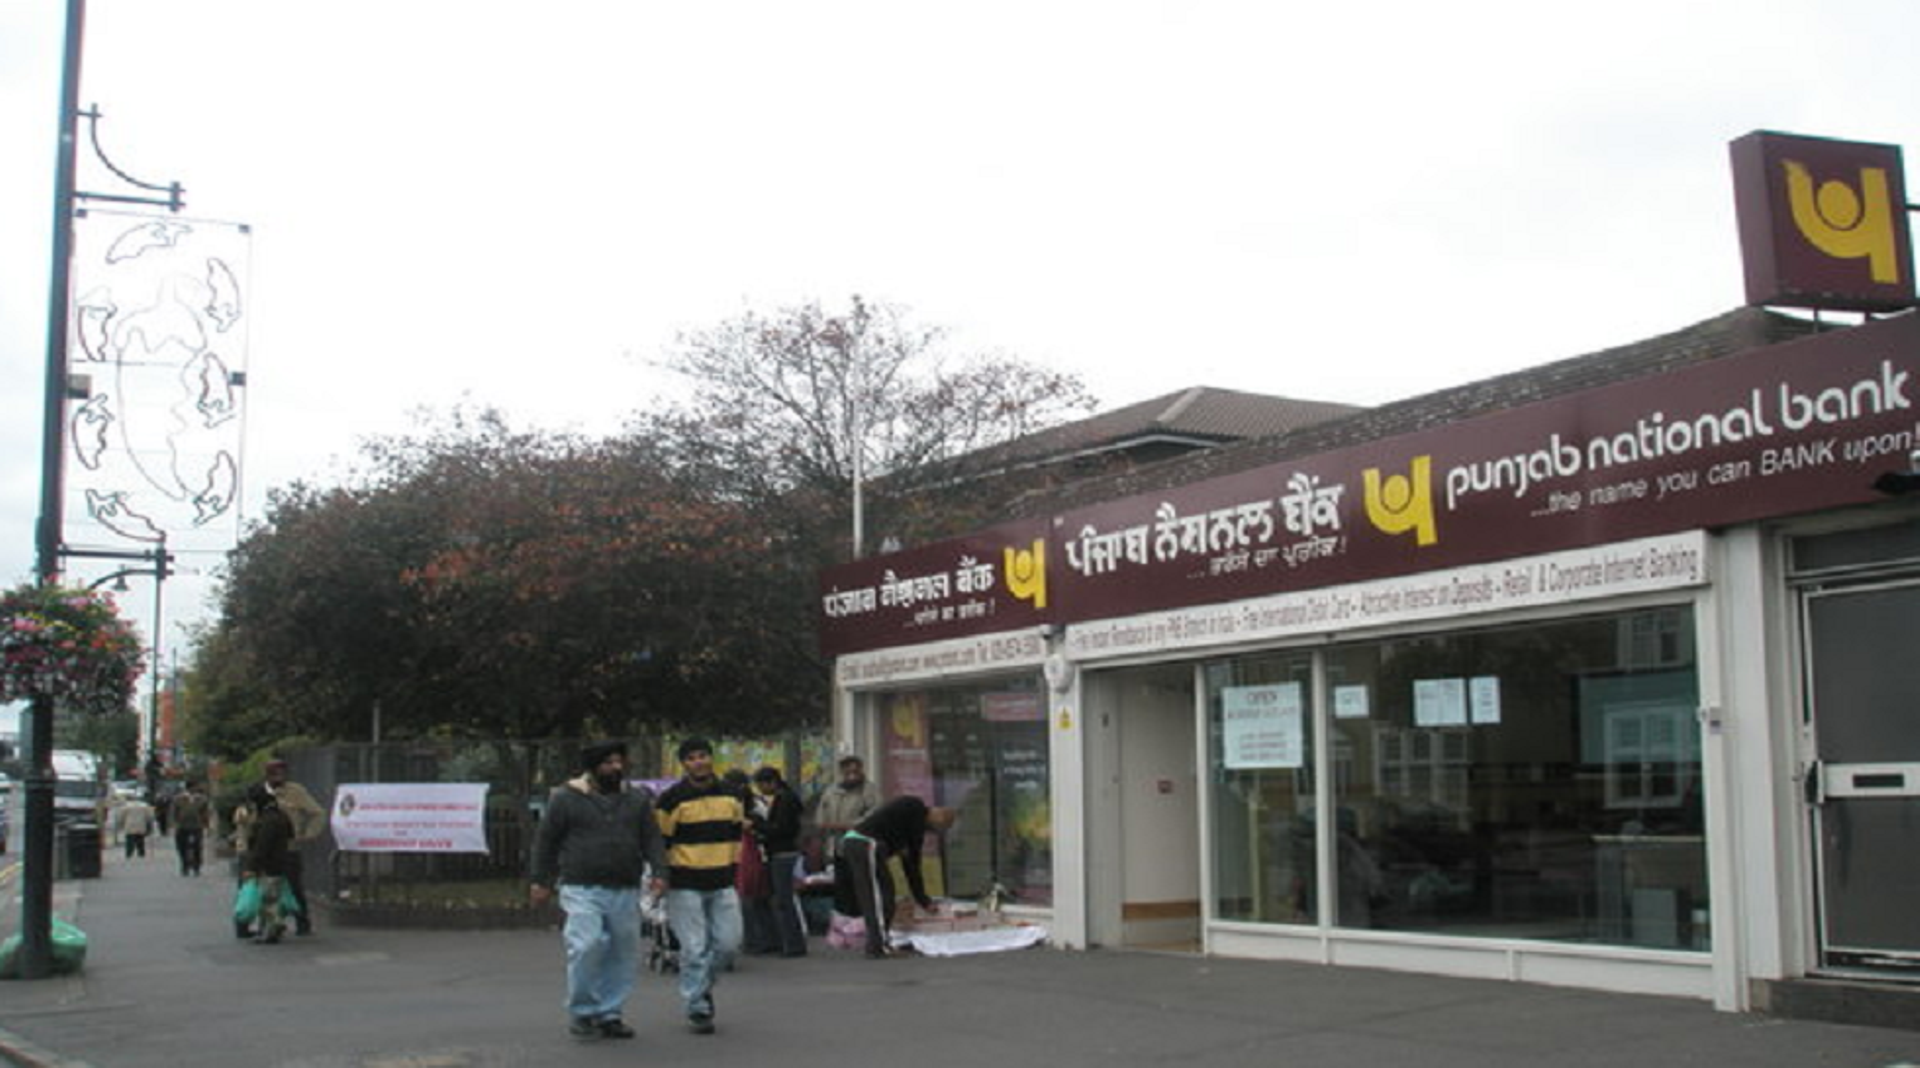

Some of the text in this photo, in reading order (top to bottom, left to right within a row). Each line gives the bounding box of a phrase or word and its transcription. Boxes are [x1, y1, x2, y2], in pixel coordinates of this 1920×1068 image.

[1446, 359, 1911, 510] punjab national bank
[1590, 477, 1648, 505] name
[1656, 472, 1698, 500] you
[1707, 460, 1751, 486] can
[1760, 438, 1835, 476] BANK
[1065, 523, 1151, 577] ਪੰਜਾਬ
[1280, 472, 1345, 536] ਬੈਂਕ
[1452, 573, 1493, 609] Deposits
[1503, 566, 1531, 597] Retail
[1549, 557, 1602, 593] Corporate
[1604, 553, 1646, 583] Internet
[1649, 545, 1697, 582] Banking
